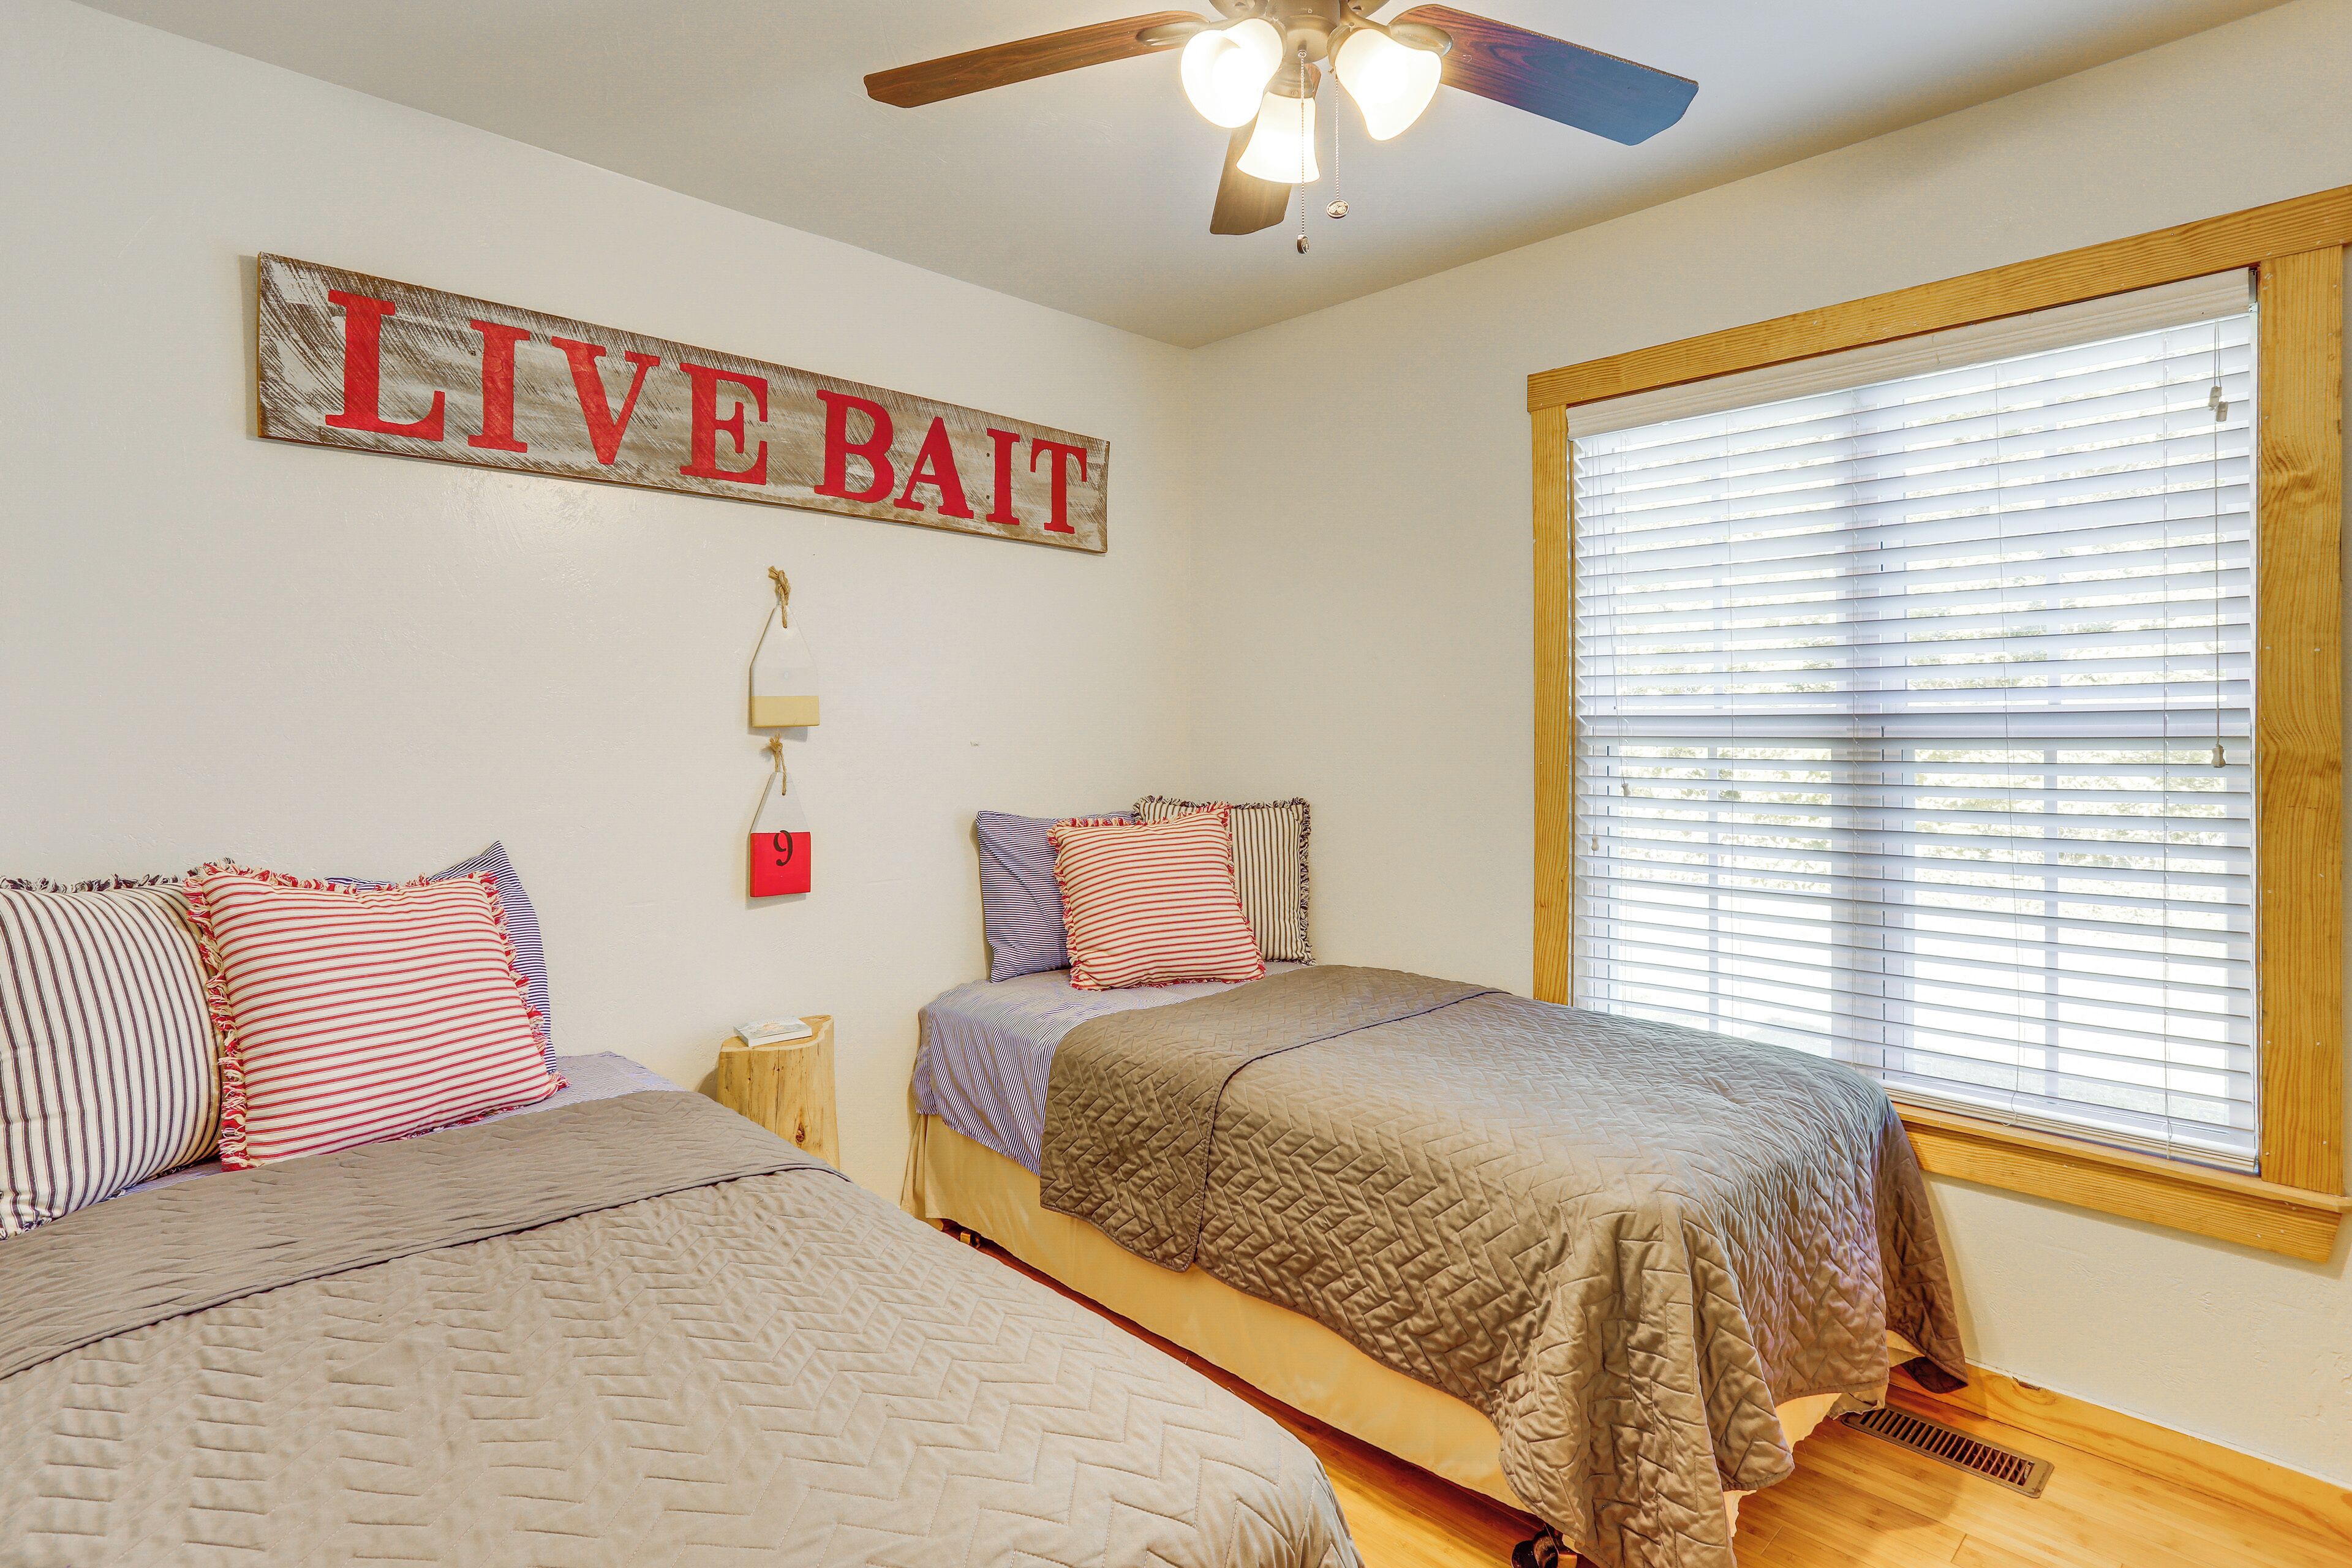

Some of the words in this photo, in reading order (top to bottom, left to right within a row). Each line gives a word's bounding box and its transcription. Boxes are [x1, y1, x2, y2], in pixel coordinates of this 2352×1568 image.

[325, 288, 768, 486] LIVE
[814, 390, 1088, 534] BAIT
[773, 830, 793, 866] 9
